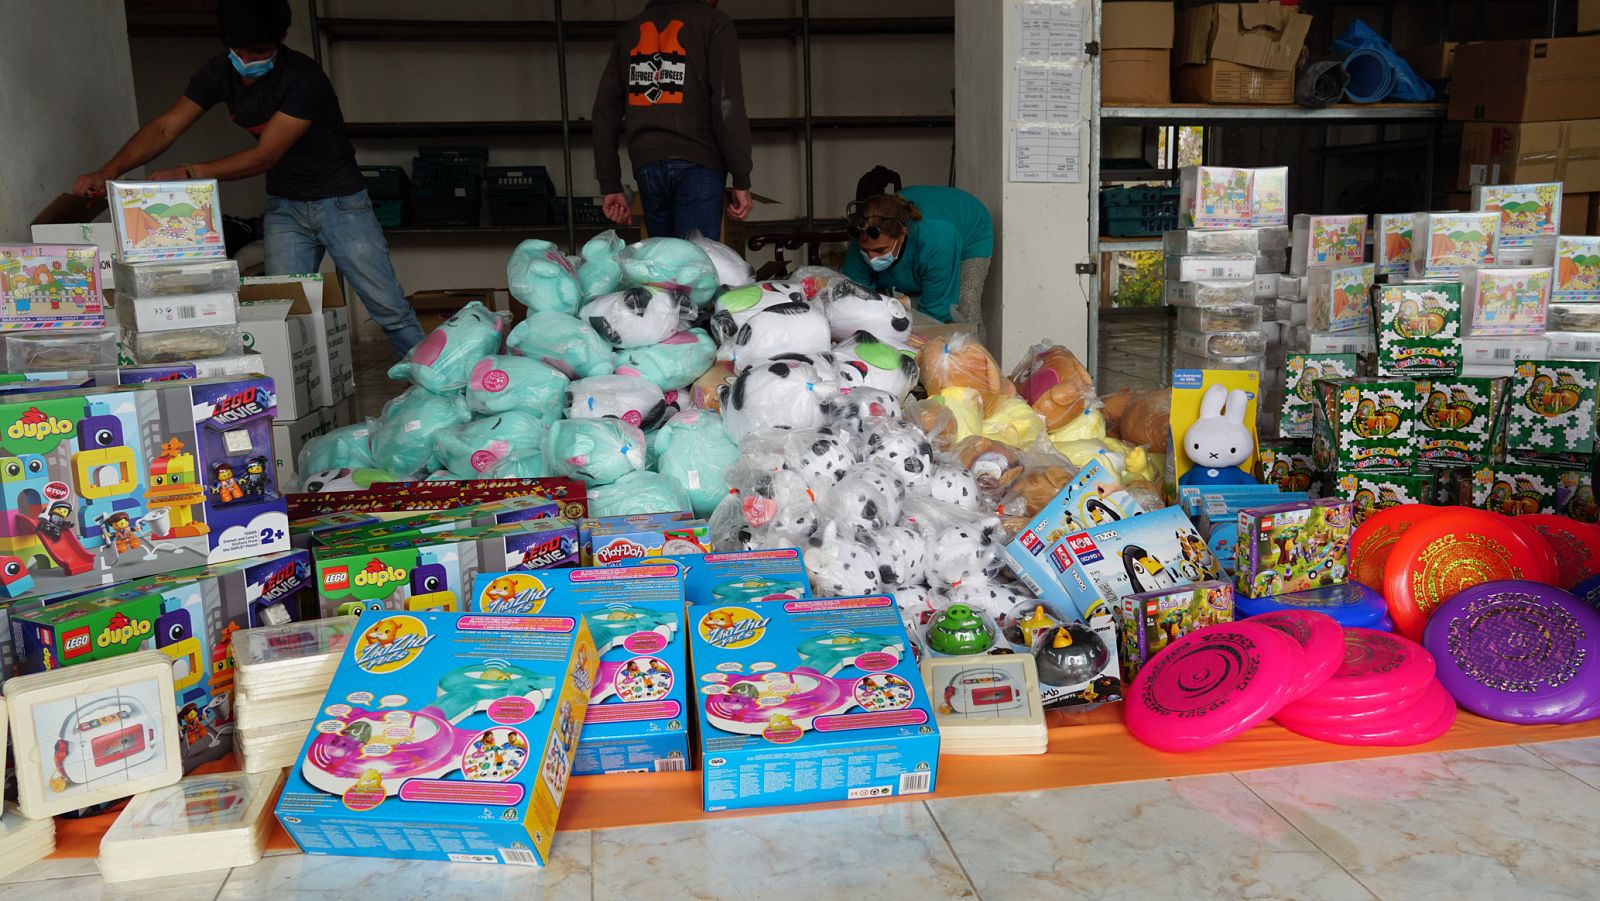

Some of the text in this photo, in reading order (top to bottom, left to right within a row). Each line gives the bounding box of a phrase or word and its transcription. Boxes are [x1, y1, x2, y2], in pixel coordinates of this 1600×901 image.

[213, 387, 256, 416] LEGO
[213, 403, 263, 424] MOVIE
[8, 417, 73, 441] duplo
[46, 486, 67, 496] STOP
[261, 528, 284, 545] 2+
[1022, 532, 1037, 547] KOR
[1070, 537, 1092, 550] KOR
[522, 536, 560, 562] LEGO
[599, 543, 644, 561] Play-Doh
[1056, 547, 1071, 567] KOR
[523, 550, 566, 570] MOVIE
[262, 562, 295, 594] LEGO
[325, 566, 408, 587] LEGO duplo
[263, 576, 300, 602] MOVIE
[65, 619, 151, 651] LEGO duplo
